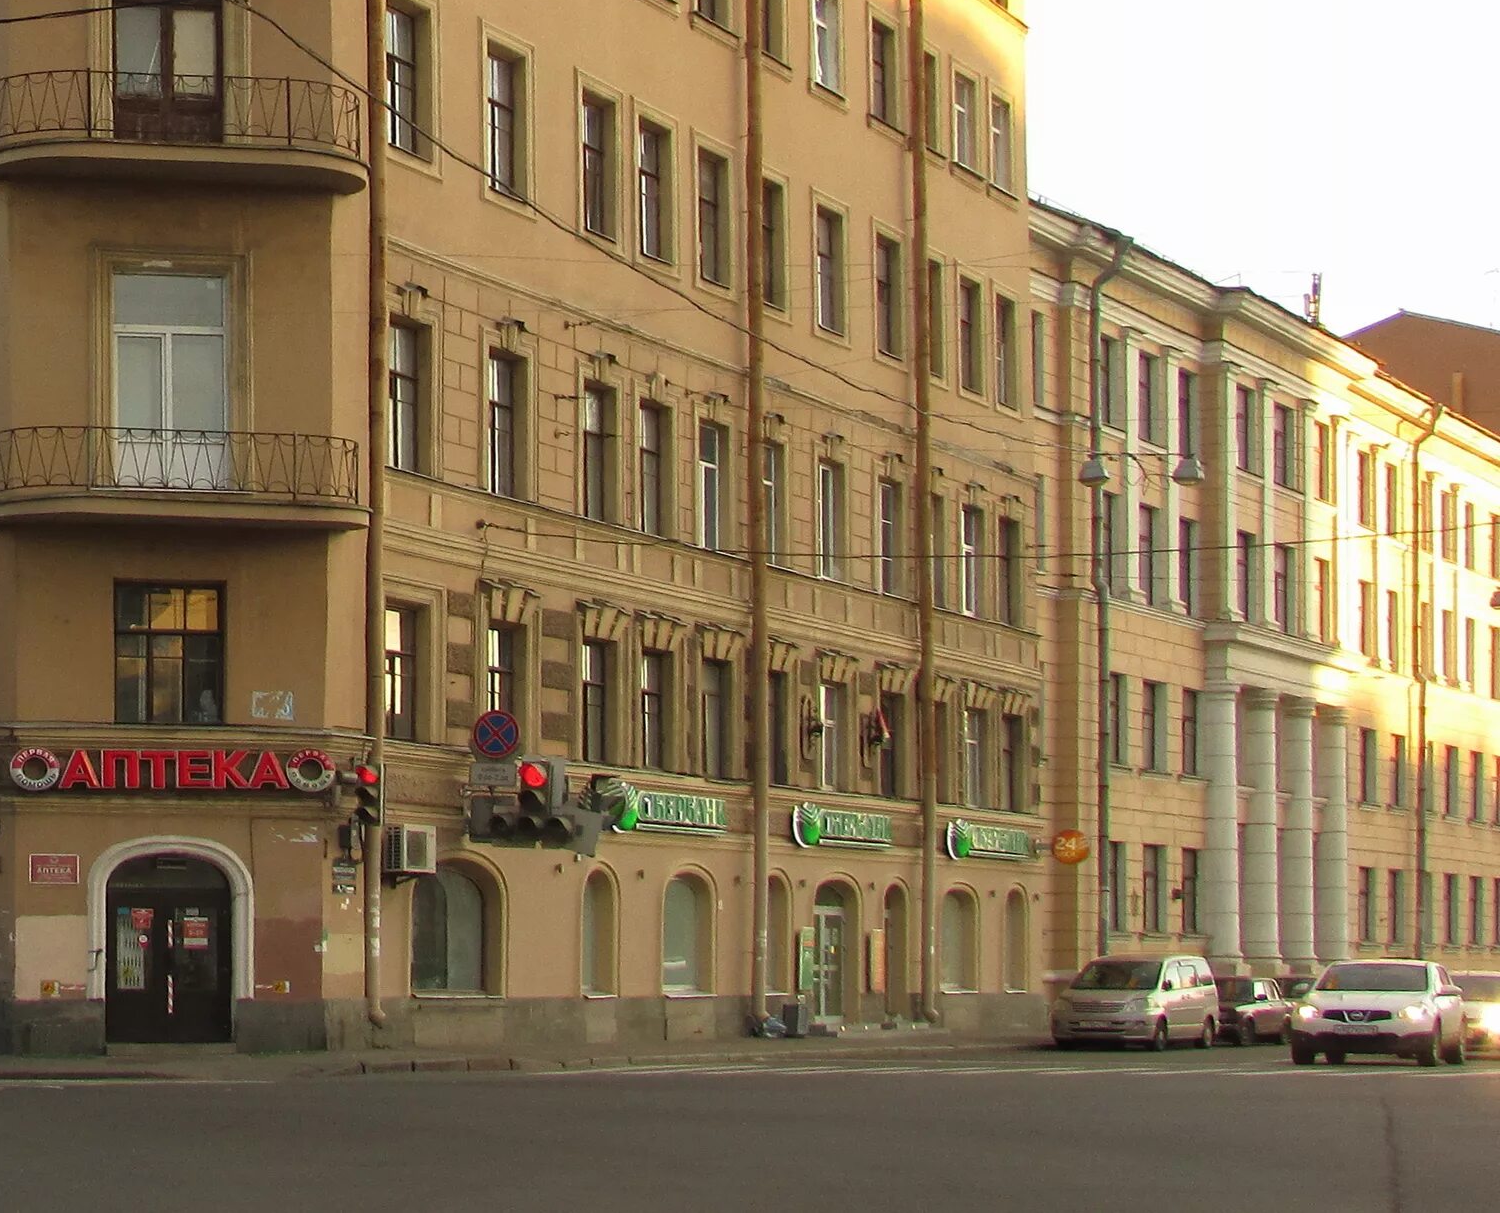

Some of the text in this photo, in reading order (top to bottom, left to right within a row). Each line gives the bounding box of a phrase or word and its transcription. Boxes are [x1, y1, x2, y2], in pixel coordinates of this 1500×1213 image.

[16, 748, 56, 763] ПЕРВАЯ
[57, 748, 291, 790] АПТЕКА
[16, 773, 57, 788] ПОМОЩЬ
[1054, 837, 1077, 850] 24
